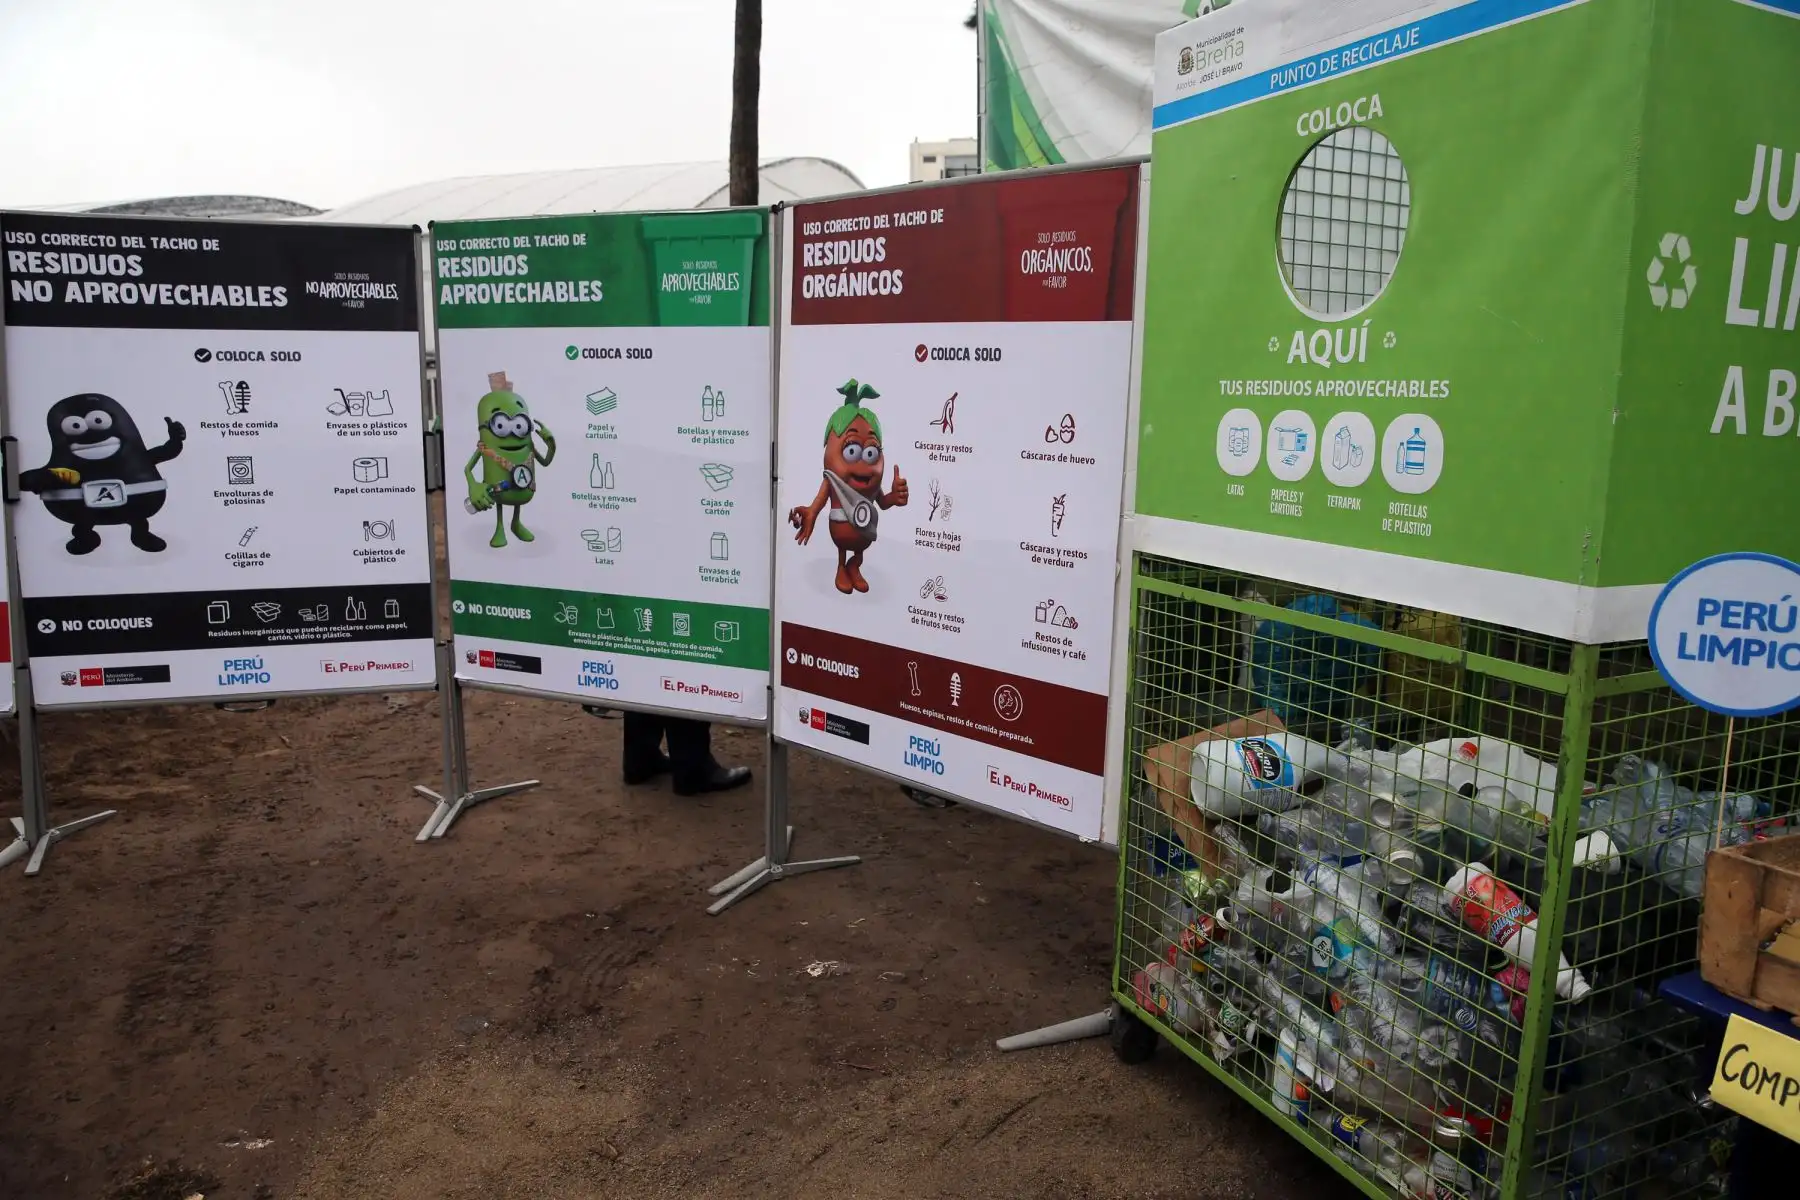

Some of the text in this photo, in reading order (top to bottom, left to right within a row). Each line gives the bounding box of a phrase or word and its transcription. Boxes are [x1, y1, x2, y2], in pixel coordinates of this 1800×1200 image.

[1196, 26, 1244, 49] Municipalidad de
[1196, 38, 1244, 71] Breña
[1270, 26, 1420, 89] PUNTO DE RECICLAJE
[1216, 69, 1221, 78] LI
[1222, 62, 1243, 76] BRAVO
[1296, 93, 1383, 137] COLOCA
[803, 209, 944, 236] USO CORRECTO DEL TACHO DE
[5, 232, 219, 251] USO CORRECTO DEL TACHO DE
[437, 234, 586, 251] USO CORRECTO DEL TACHO DE
[1038, 231, 1076, 243] SOLO RESIDUOS
[803, 237, 886, 268] RESIDUOS
[1021, 243, 1093, 274] ORGÁNICOS.
[8, 251, 143, 276] RESIDUOS
[438, 255, 528, 278] RESIDUOS
[662, 272, 739, 292] APROVECHABLES
[802, 268, 903, 299] ORGÁNICOS
[1725, 237, 1800, 331] LI
[11, 280, 287, 307] NO APROVECHABLES
[305, 281, 399, 300] NO APROVECHABLES,
[440, 280, 603, 305] APROVECHABLES
[1287, 319, 1372, 368] AQUÍ
[216, 351, 301, 362] COLOCA SOLO
[582, 347, 653, 360] COLOCA SOLO
[931, 347, 1002, 362] COLOCA SOLO
[1220, 380, 1450, 398] TUS RESIDUOS APROVECHABLES
[1710, 365, 1800, 436] A B
[200, 421, 278, 429] Restos de comida
[370, 421, 407, 430] plásticos
[588, 423, 608, 433] Papel
[678, 427, 709, 435] Botellas
[585, 432, 617, 440] cartulina
[703, 437, 735, 445] plástico
[914, 441, 973, 453] Cáscaras y restos
[929, 453, 956, 462] de fruta
[1020, 450, 1095, 465] Cáscaras de huevo
[214, 489, 274, 498] Envolturas de
[334, 486, 416, 496] Papel contaminado
[1227, 484, 1244, 496] LATAS
[1271, 489, 1304, 502] PAPELES Y
[224, 497, 265, 507] golosinas
[600, 502, 620, 510] vidrio
[701, 499, 722, 508] Cajas
[1270, 502, 1302, 517] CARTONES
[1327, 494, 1361, 510] TETRAPAK
[705, 507, 730, 516] cartón
[1388, 502, 1428, 519] BOTELLAS
[1382, 518, 1432, 536] DE PLASTICO
[915, 528, 961, 543] Flores y hojas
[353, 548, 405, 557] Cubiertos de
[936, 541, 961, 552] césped
[1020, 541, 1088, 560] Cáscaras y restos
[225, 552, 257, 560] Colillas
[233, 559, 264, 568] cigarro
[363, 556, 396, 565] plástico
[595, 556, 614, 565] Latas
[1031, 554, 1074, 569] de verdura
[699, 566, 729, 575] Envases
[701, 574, 739, 584] tetrabrick
[469, 603, 531, 620] NO COLOQUES
[908, 605, 965, 624] Cáscaras y restos
[1697, 595, 1798, 633] PERÚ
[62, 617, 153, 632] NO COLOQUES
[911, 616, 961, 633] de frutos secos
[1035, 631, 1073, 647] Restos de
[1021, 639, 1086, 661] infusiones y café
[1678, 632, 1800, 671] LIMPIO
[224, 655, 263, 671] PERÚ
[582, 660, 614, 675] PERÚ
[801, 653, 859, 679] NO COLOQUES
[218, 672, 271, 686] LIMPIO
[578, 675, 619, 690] LIMPIO
[909, 735, 940, 757] PERÚ
[904, 751, 945, 776] LIMPIO
[1722, 1044, 1800, 1112] COMP
